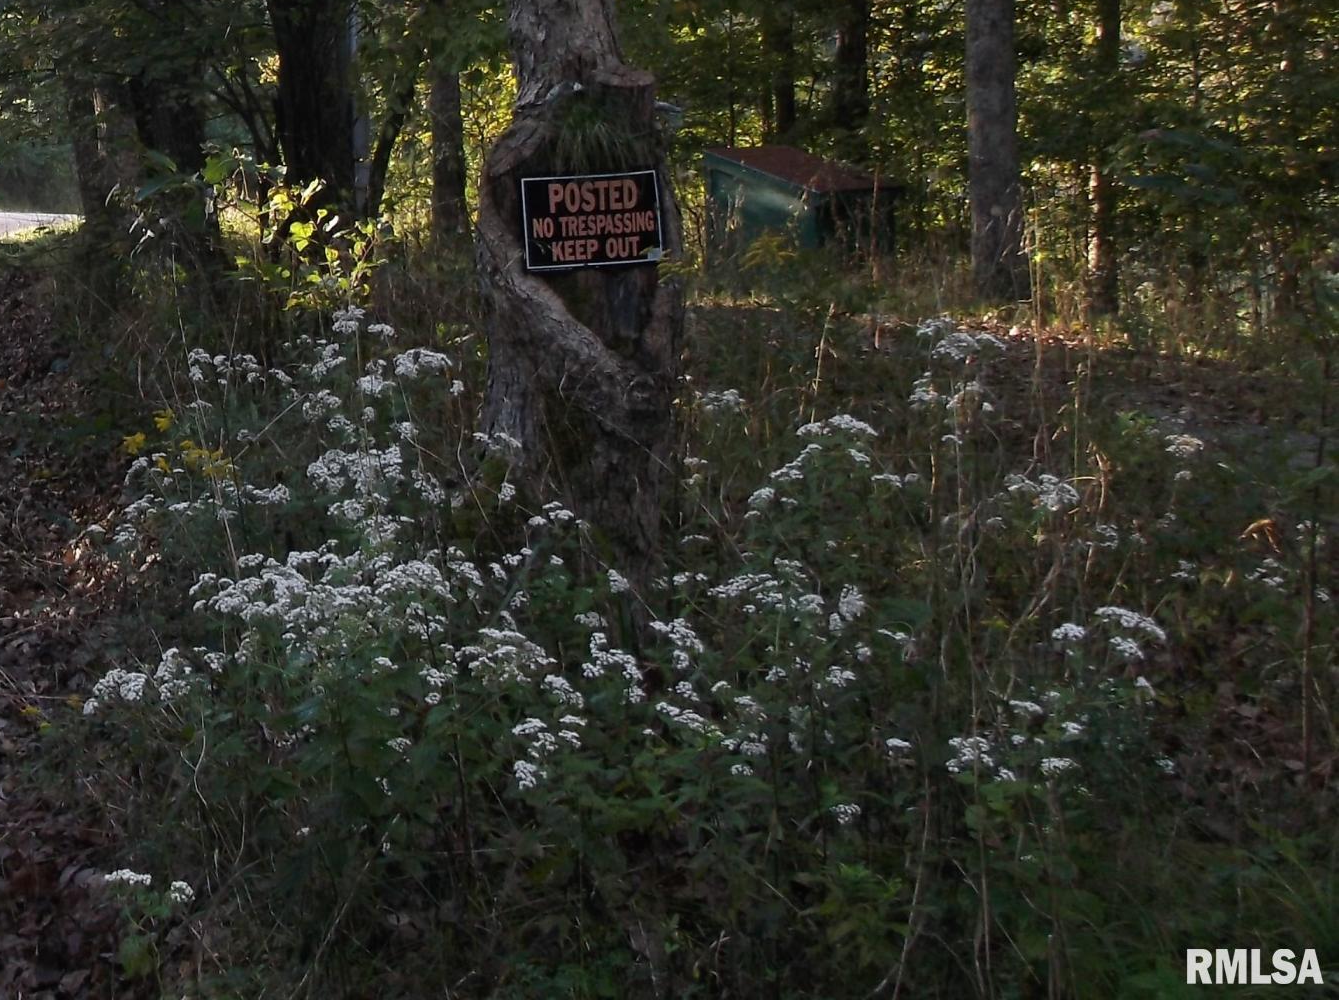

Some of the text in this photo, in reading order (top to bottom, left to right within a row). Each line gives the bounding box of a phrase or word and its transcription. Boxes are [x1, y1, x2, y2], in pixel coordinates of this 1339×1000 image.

[547, 179, 638, 214] POSTED
[532, 210, 655, 239] NO TRESPASSING
[551, 236, 640, 262] KEEP OUT
